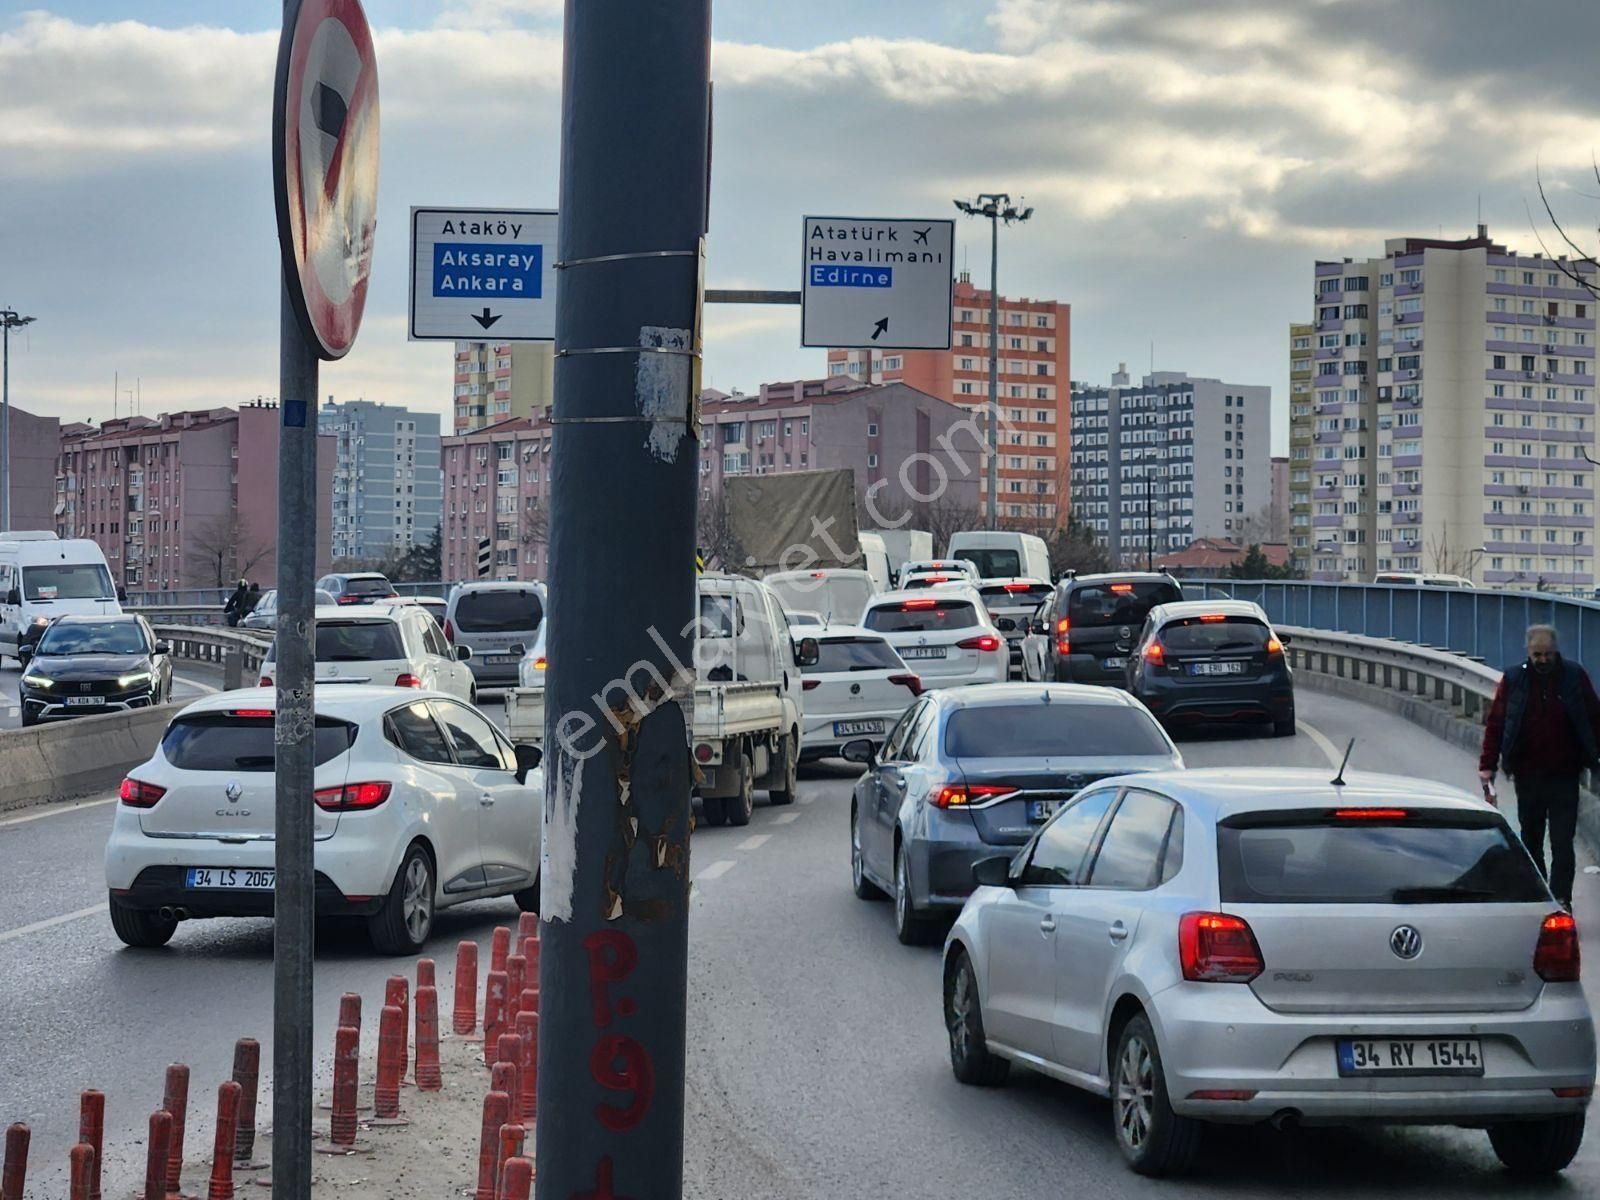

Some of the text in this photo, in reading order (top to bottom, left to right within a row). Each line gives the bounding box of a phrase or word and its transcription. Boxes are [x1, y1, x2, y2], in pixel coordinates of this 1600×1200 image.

[441, 220, 523, 239] Ataköy
[811, 225, 898, 241] Atatürk
[440, 250, 534, 271] Aksaray
[810, 246, 942, 263] Havalimanı
[440, 274, 524, 291] Ankara
[813, 267, 889, 285] Edirne
[215, 809, 251, 817] CLIO
[195, 870, 275, 888] 34 LS 2067
[1353, 1042, 1381, 1067] 34
[1390, 1042, 1415, 1066] RY
[1427, 1041, 1478, 1066] 1544
